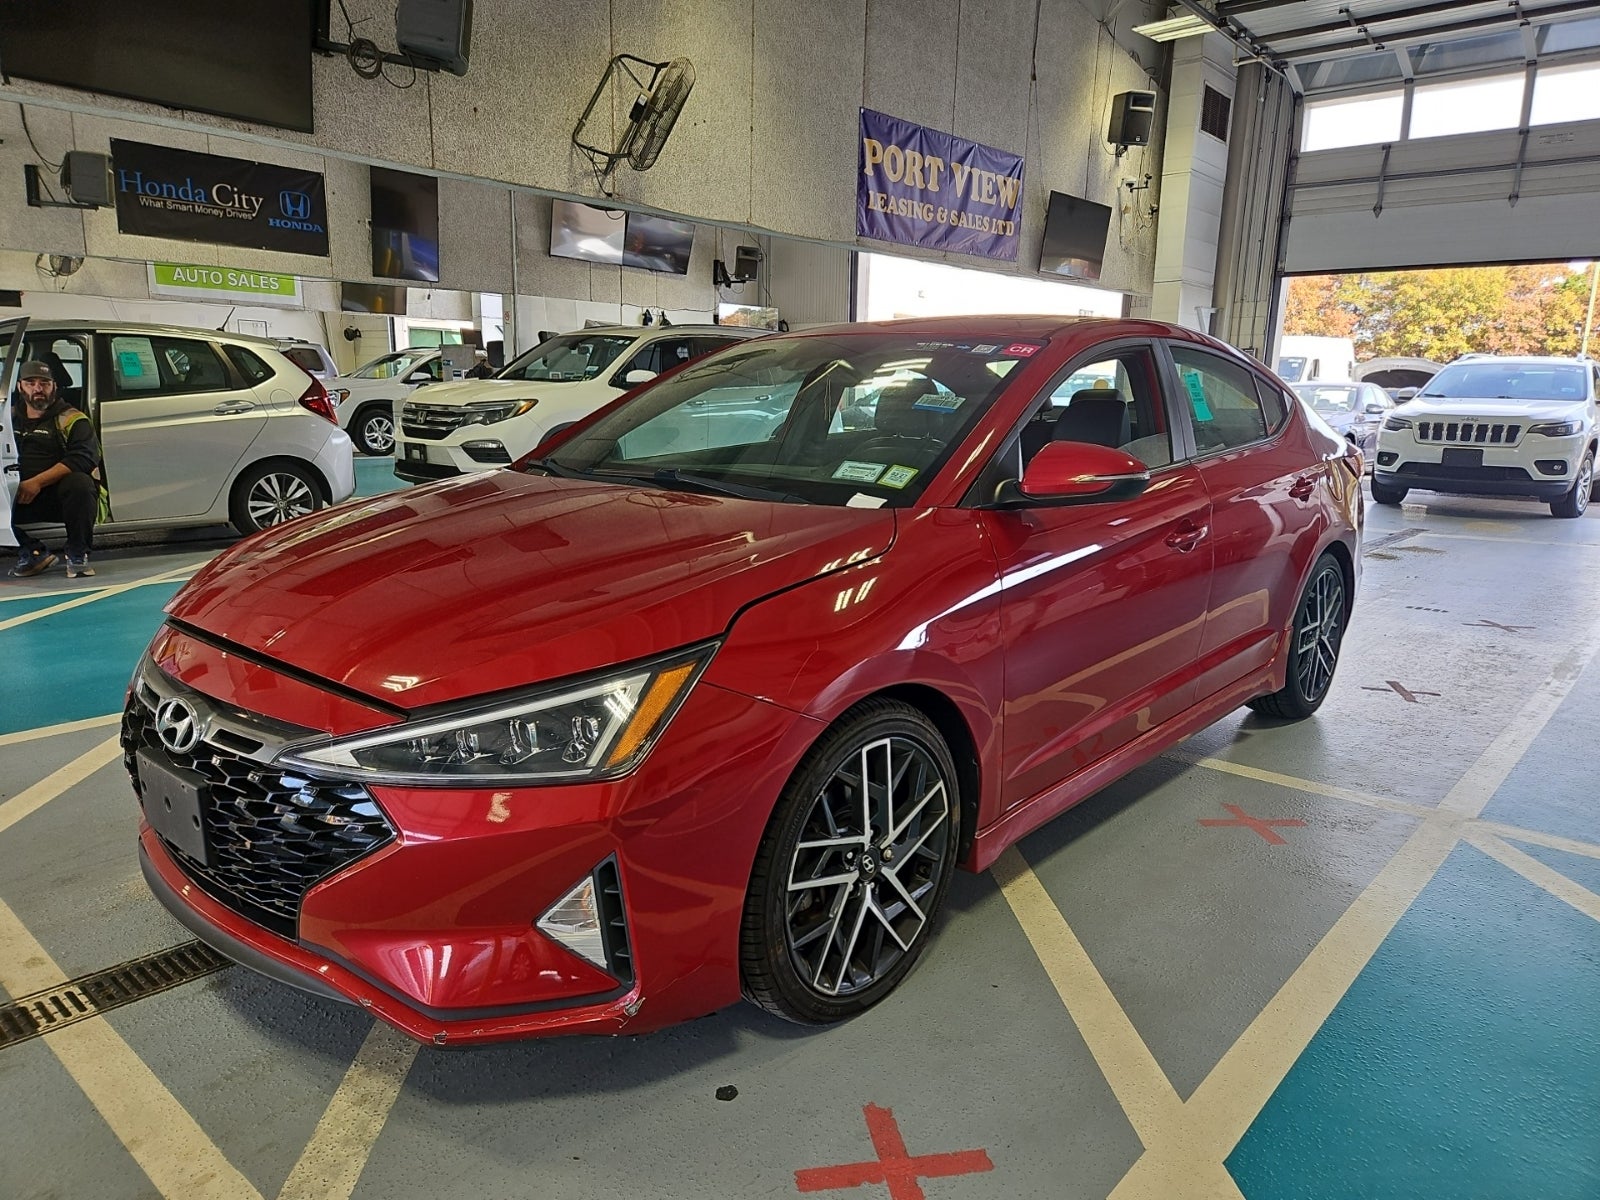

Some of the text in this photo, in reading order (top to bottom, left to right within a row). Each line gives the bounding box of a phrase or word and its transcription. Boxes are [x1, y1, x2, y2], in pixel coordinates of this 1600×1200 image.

[863, 138, 1020, 210] PORT VIEW
[118, 168, 264, 216] Honda City
[139, 197, 253, 220] What Smart Money Drives
[868, 191, 1014, 237] LEASING & SALES LTD
[267, 217, 324, 233] HONDA
[173, 267, 280, 290] AUTO SALES
[1010, 346, 1034, 354] CR
